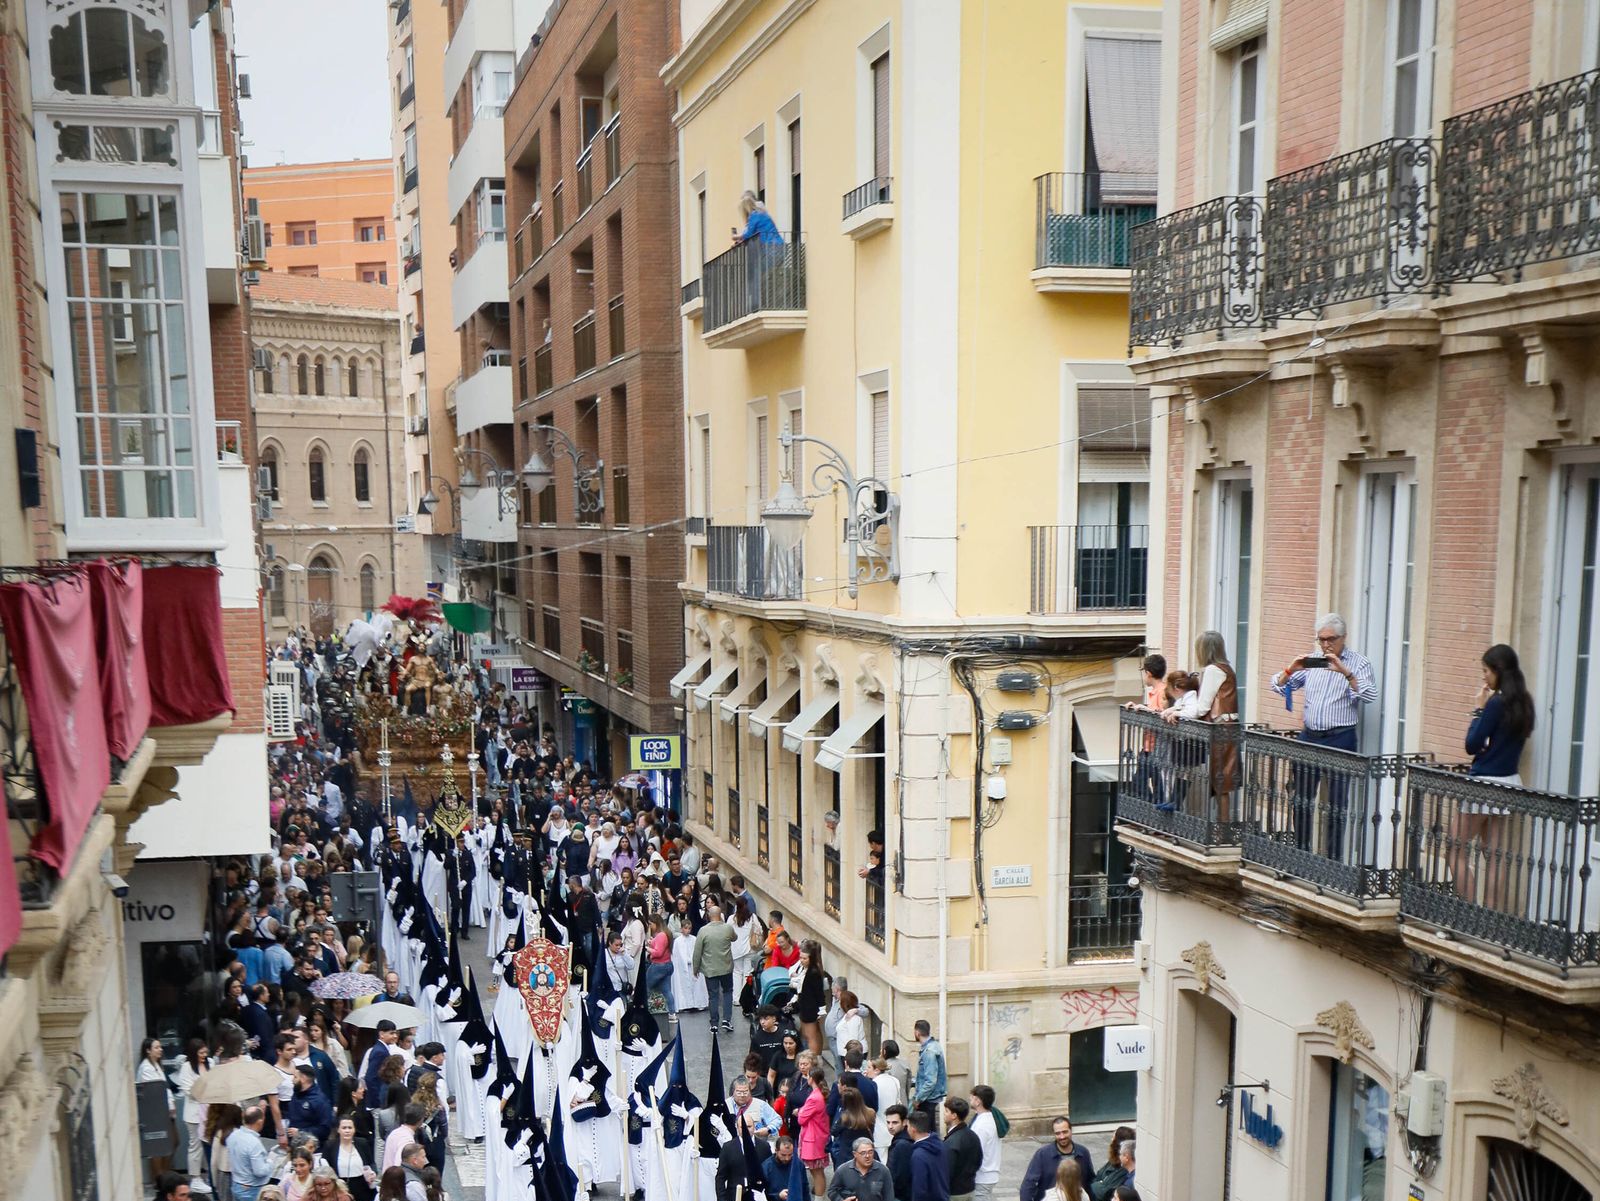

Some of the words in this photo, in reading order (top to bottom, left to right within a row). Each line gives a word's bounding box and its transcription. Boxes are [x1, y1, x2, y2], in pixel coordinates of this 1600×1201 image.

[643, 741, 668, 750] LOOK
[645, 751, 668, 761] FIND
[1116, 1041, 1146, 1055] Nude
[1238, 1089, 1284, 1150] Nude
